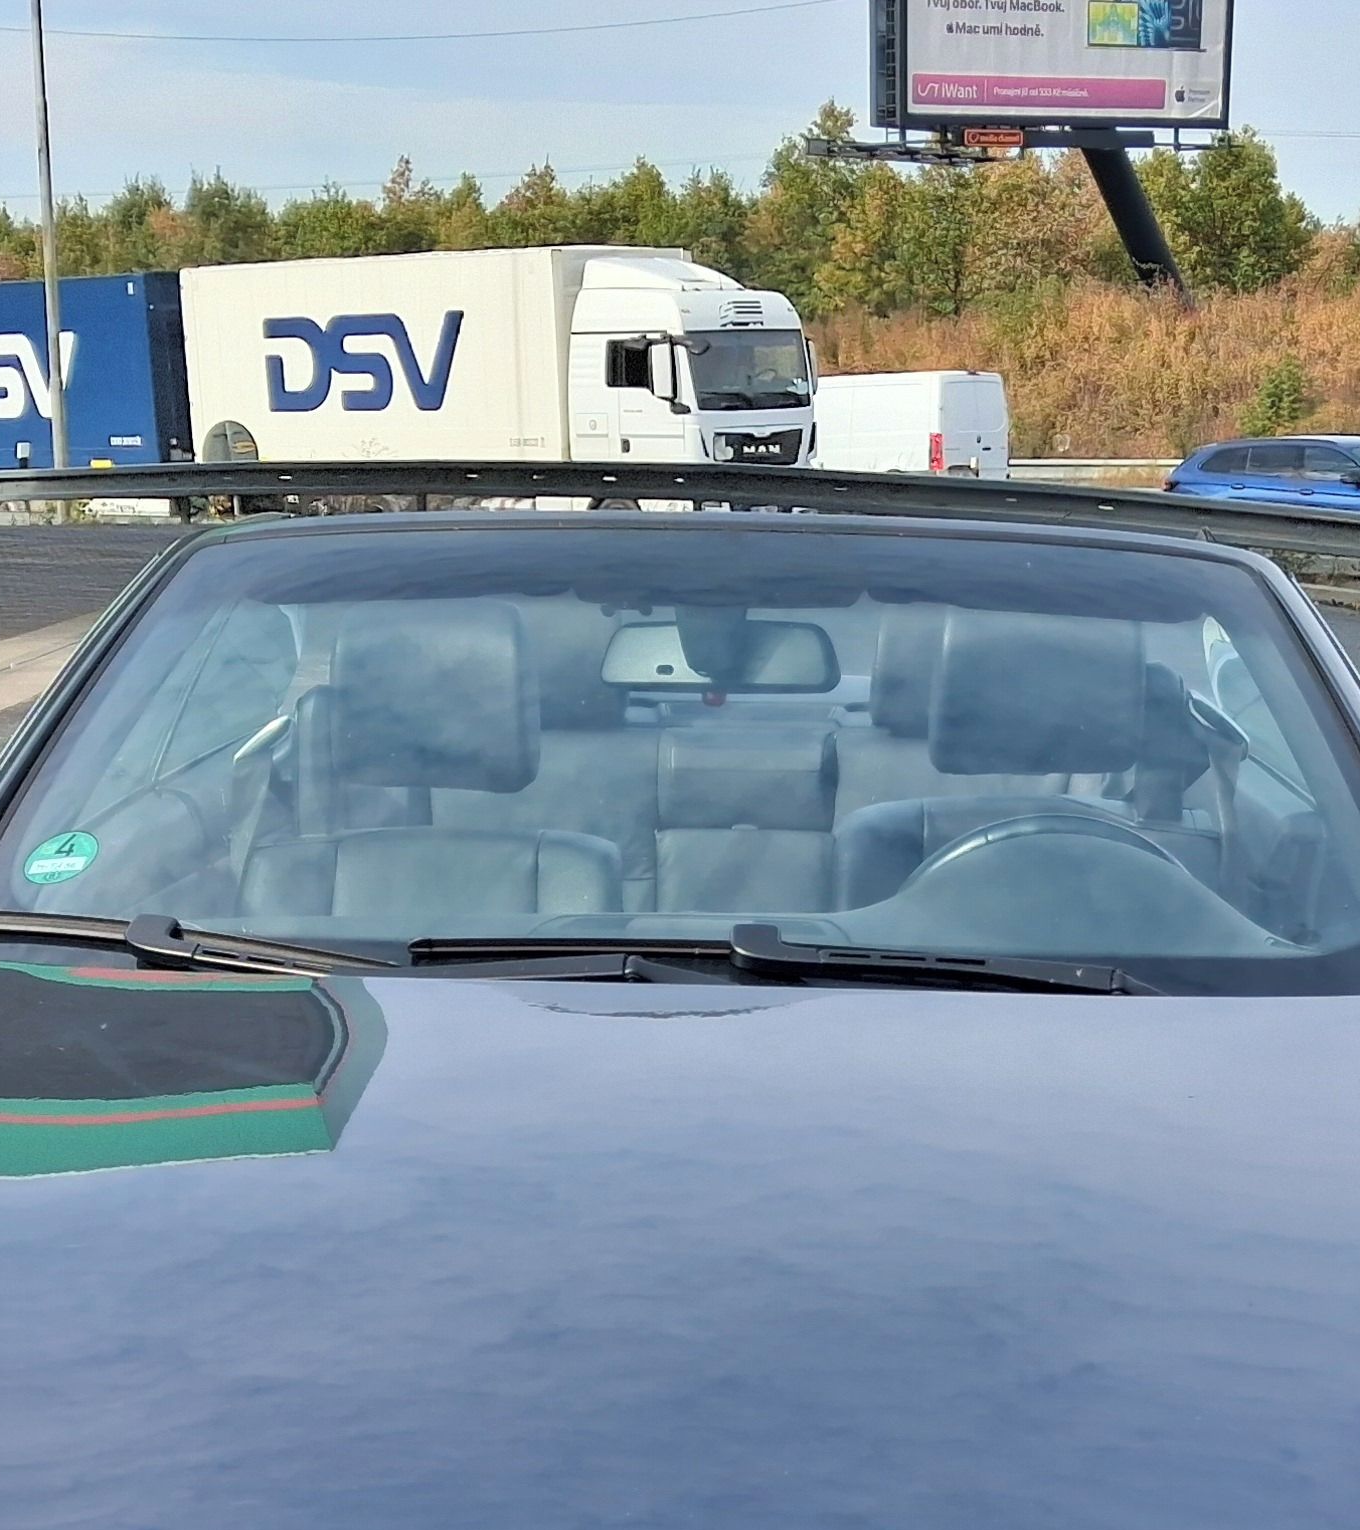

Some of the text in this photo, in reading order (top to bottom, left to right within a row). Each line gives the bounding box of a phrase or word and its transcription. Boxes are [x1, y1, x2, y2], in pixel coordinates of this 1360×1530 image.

[1009, 0, 1065, 13] MacBook.
[955, 21, 980, 35] Mac
[1004, 22, 1045, 37] hodně.
[942, 82, 978, 98] iWant
[263, 309, 465, 412] DSV
[742, 443, 781, 455] MAN
[54, 833, 77, 857] 4
